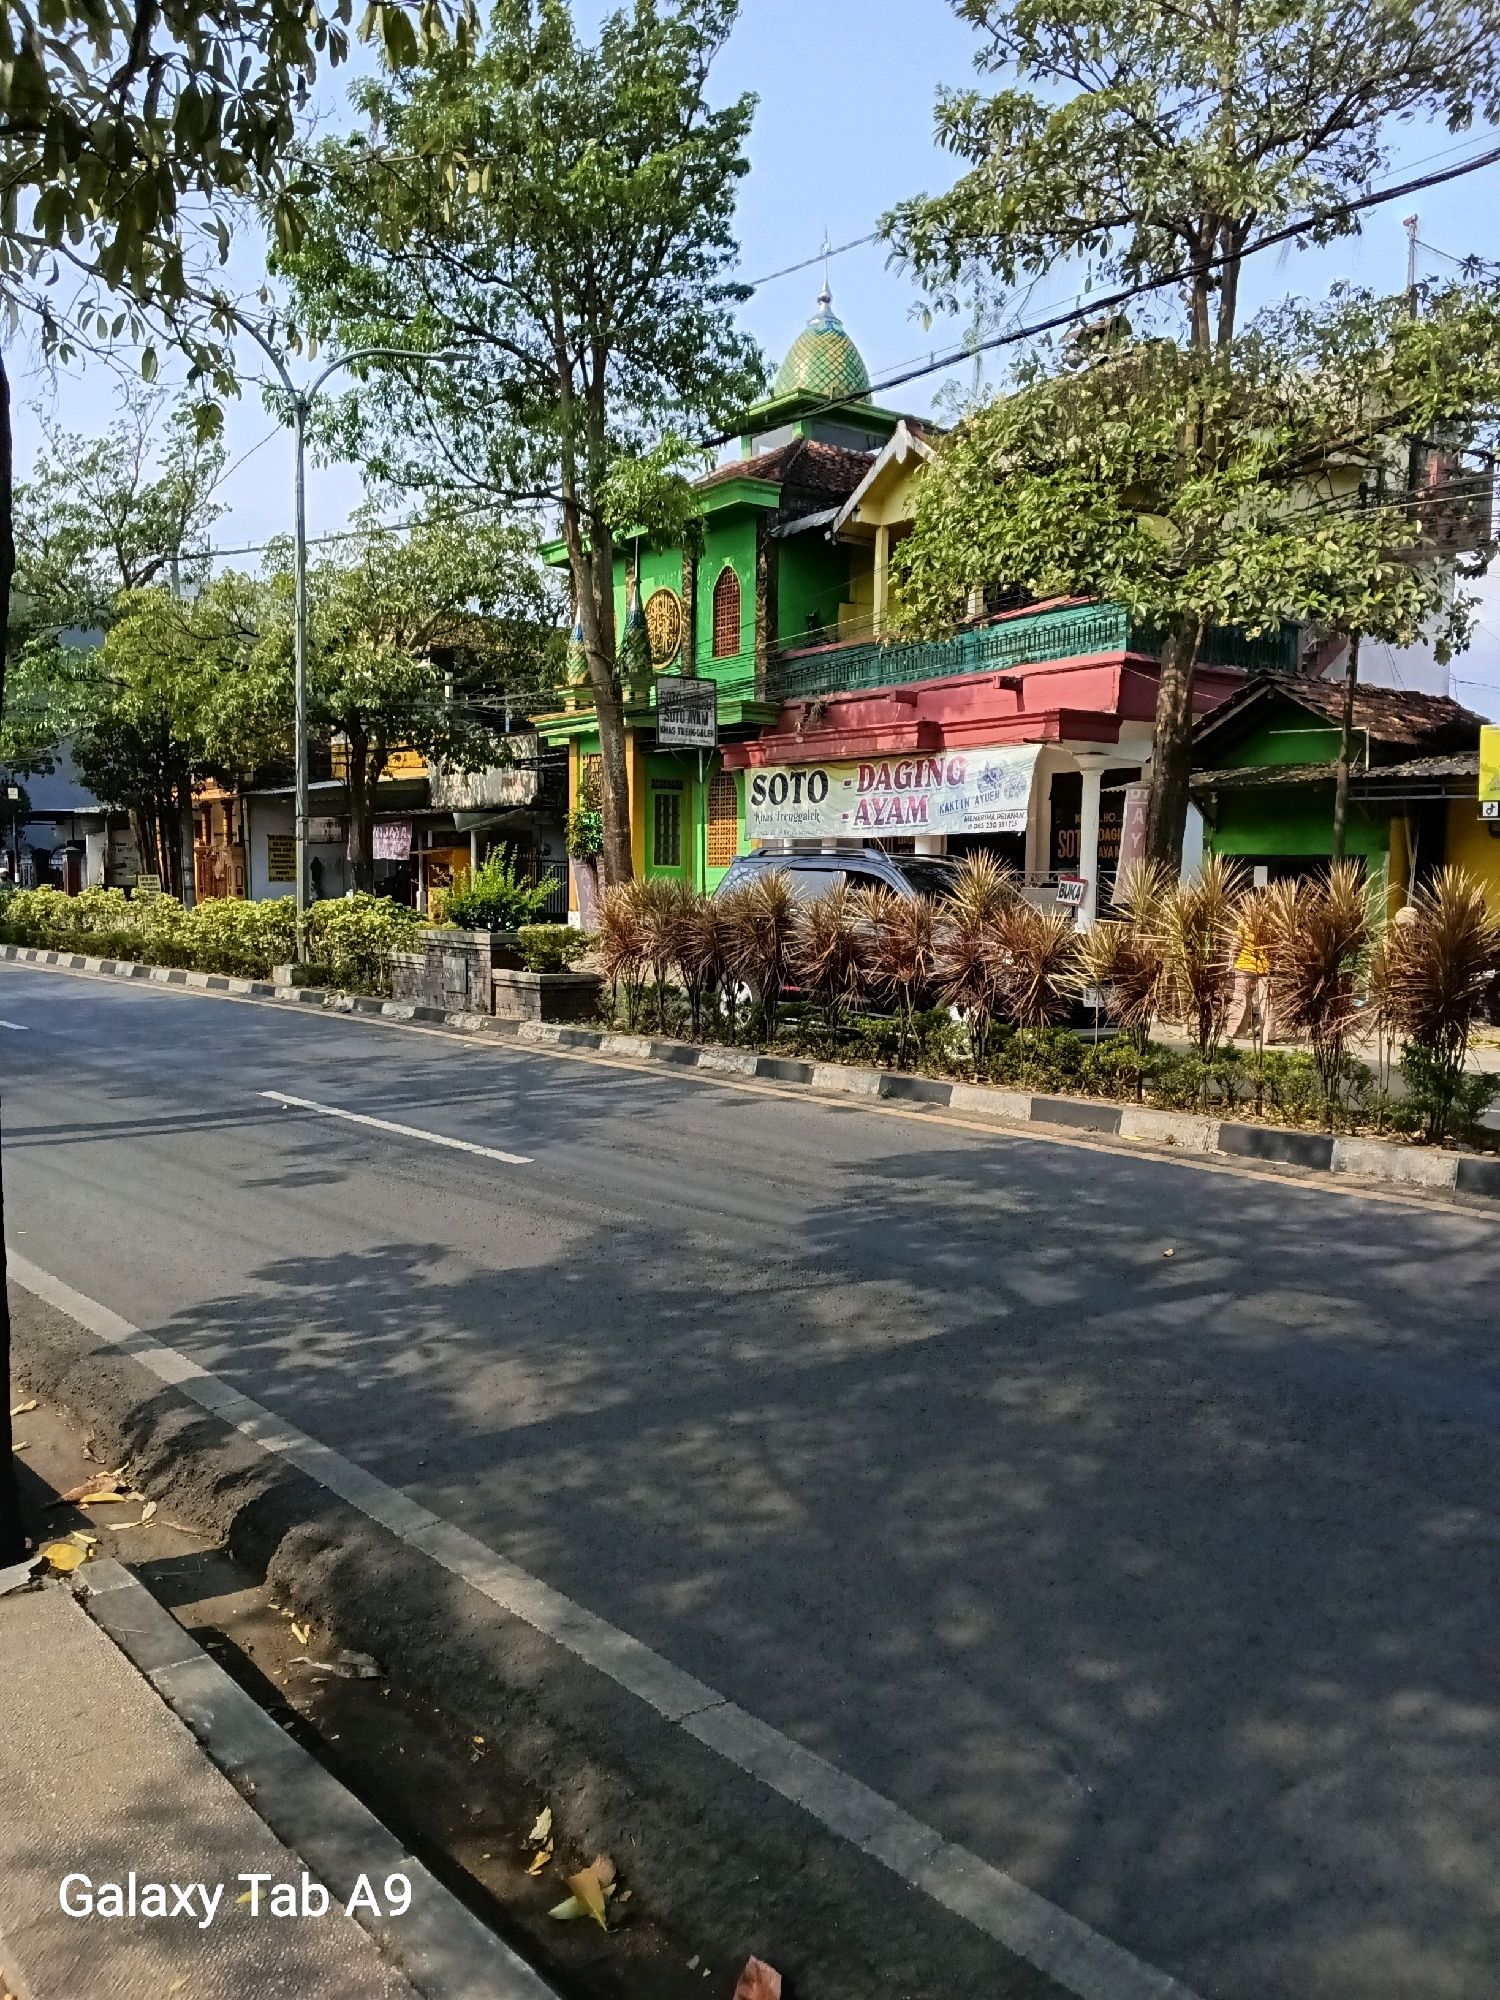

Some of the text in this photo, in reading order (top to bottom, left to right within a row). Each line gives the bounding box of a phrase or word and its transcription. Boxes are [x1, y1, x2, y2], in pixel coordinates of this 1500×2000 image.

[660, 725, 676, 735] KHAS
[751, 769, 829, 806] SOTO
[857, 755, 966, 793] DAGING
[853, 795, 929, 826] AYAM
[1057, 829, 1081, 859] SOT
[1098, 828, 1121, 842] DAGI
[1058, 882, 1082, 902] BUKA
